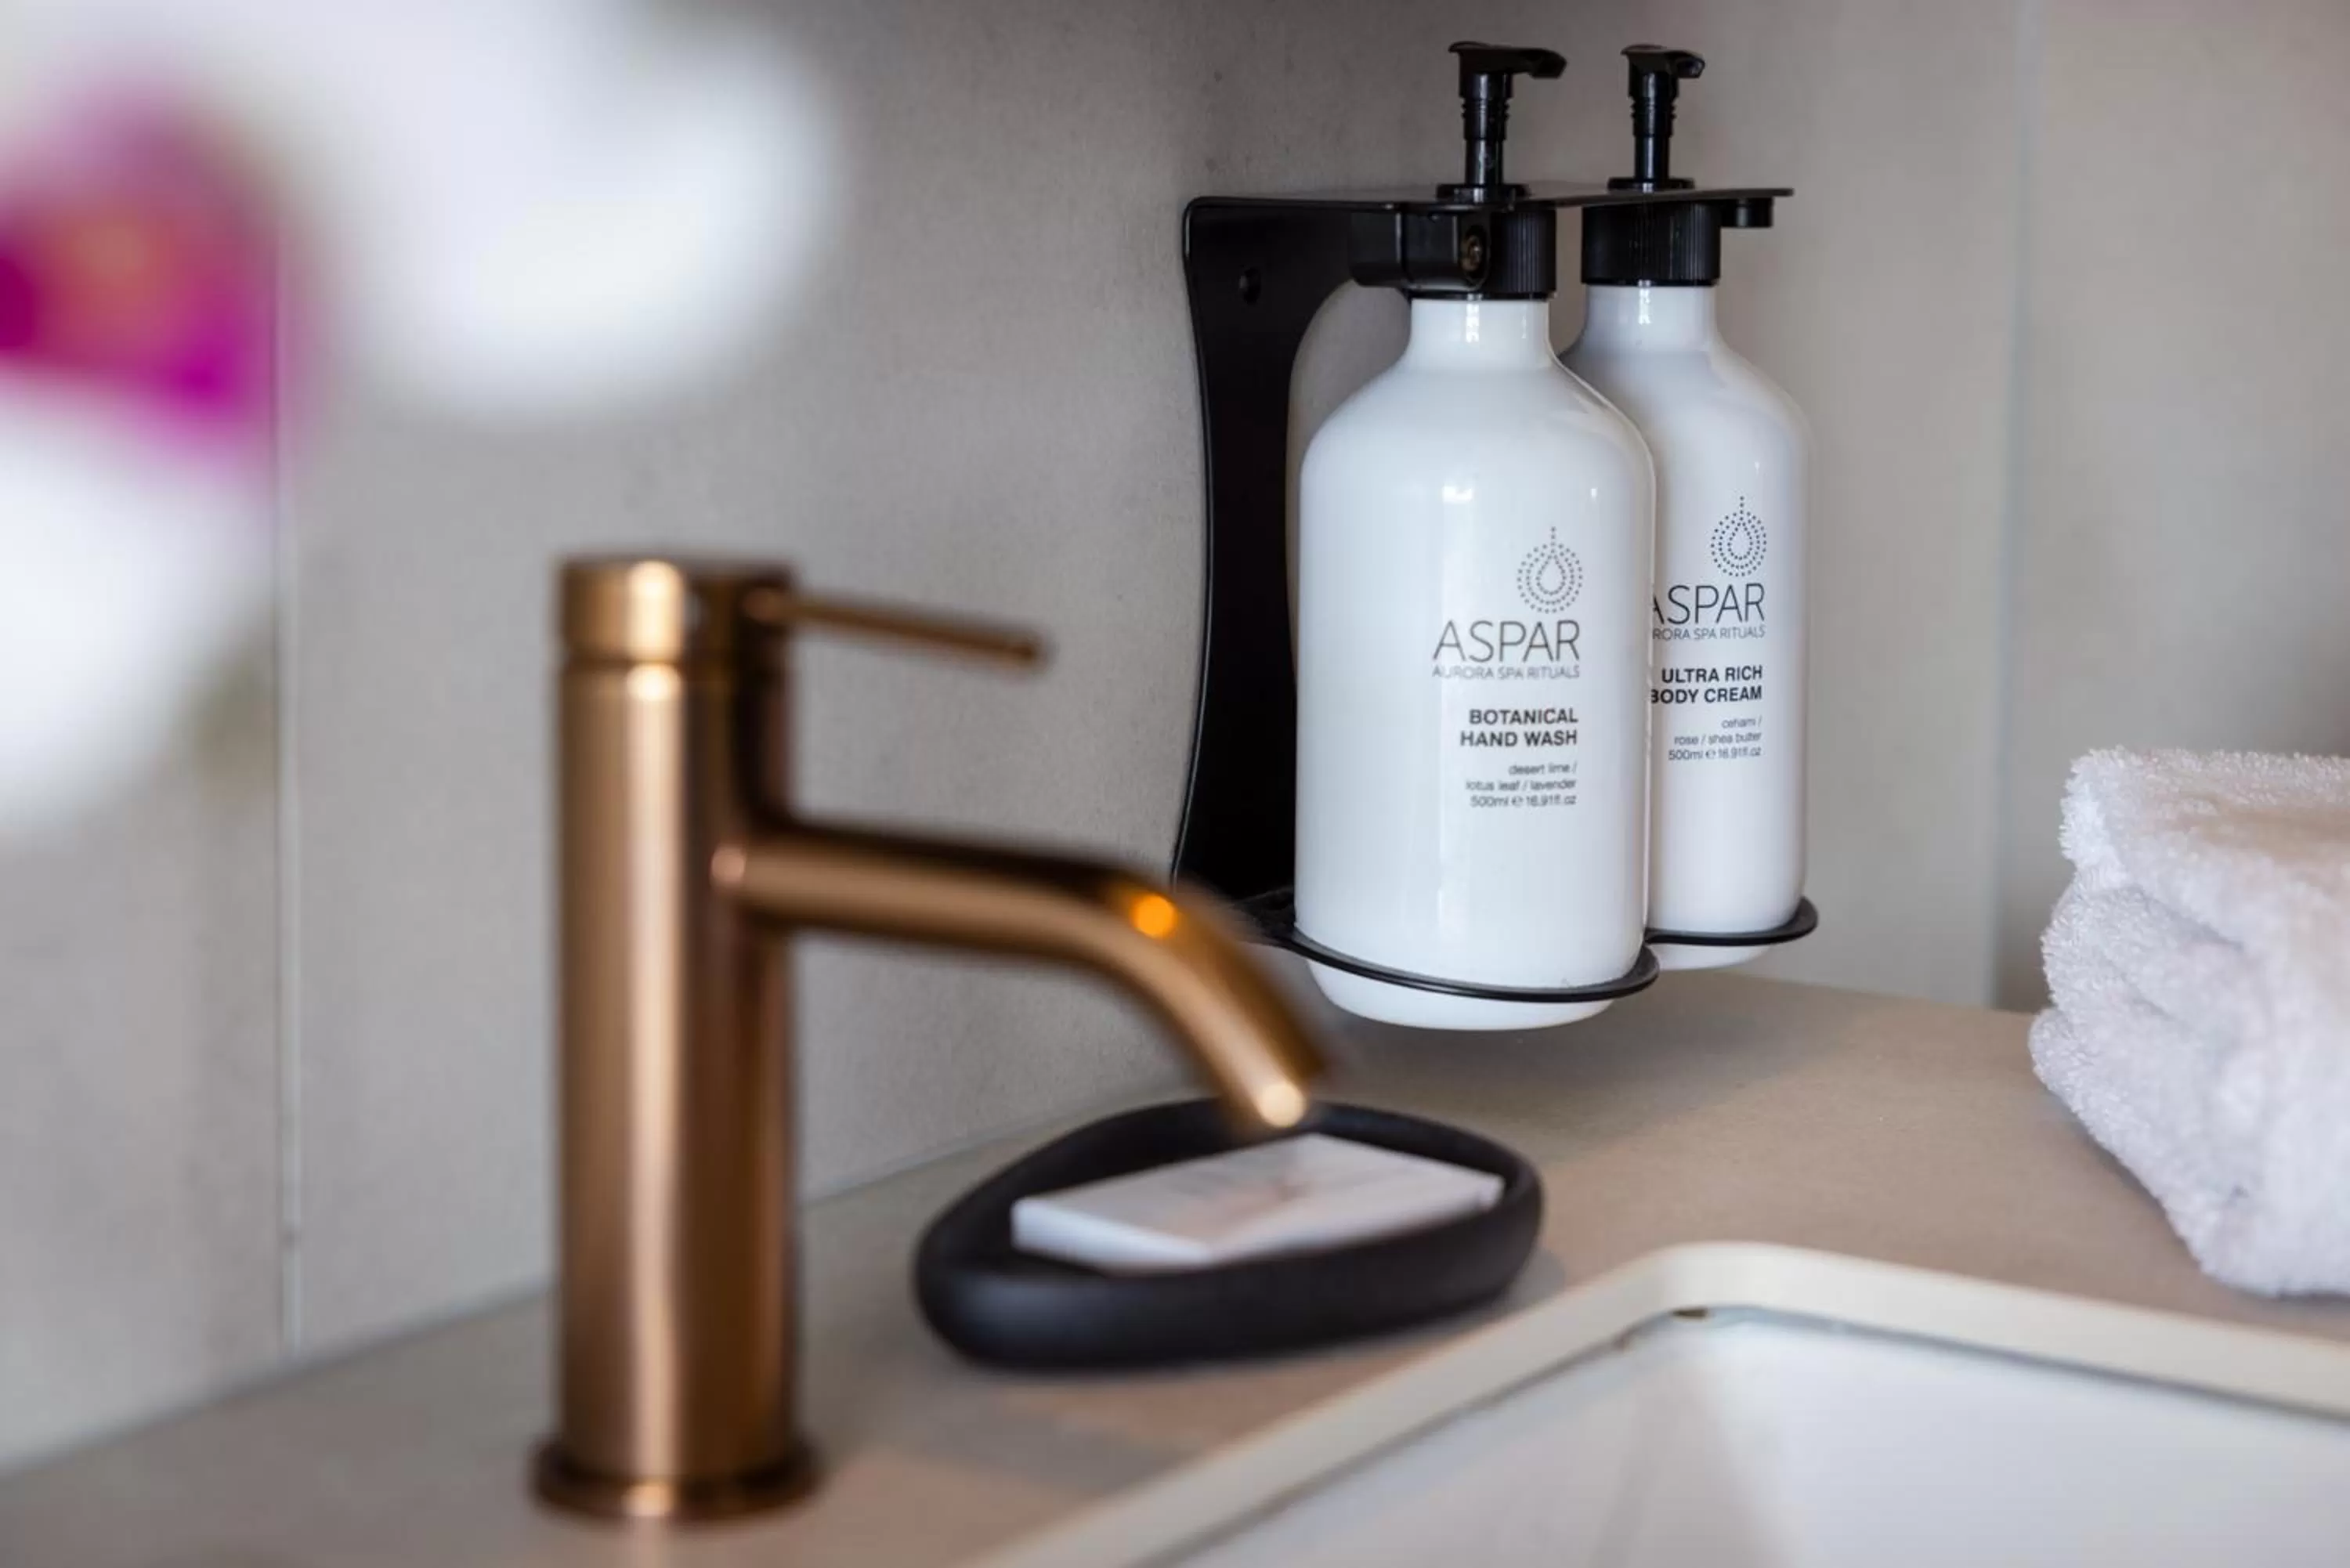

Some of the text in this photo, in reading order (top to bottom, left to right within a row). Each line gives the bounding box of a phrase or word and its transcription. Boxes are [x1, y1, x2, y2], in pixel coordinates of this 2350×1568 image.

[1653, 624, 1766, 641] RORA SPA RITUALS
[1433, 620, 1580, 663] ASPAR
[1498, 667, 1524, 680] SPA
[1528, 665, 1579, 679] RITUALS
[1661, 665, 1762, 683] ULTRA RICH
[1704, 685, 1762, 703] CREAM
[1469, 707, 1578, 724] BOTANICAL
[1460, 729, 1578, 746] HAND WASH
[1708, 734, 1733, 743] shea
